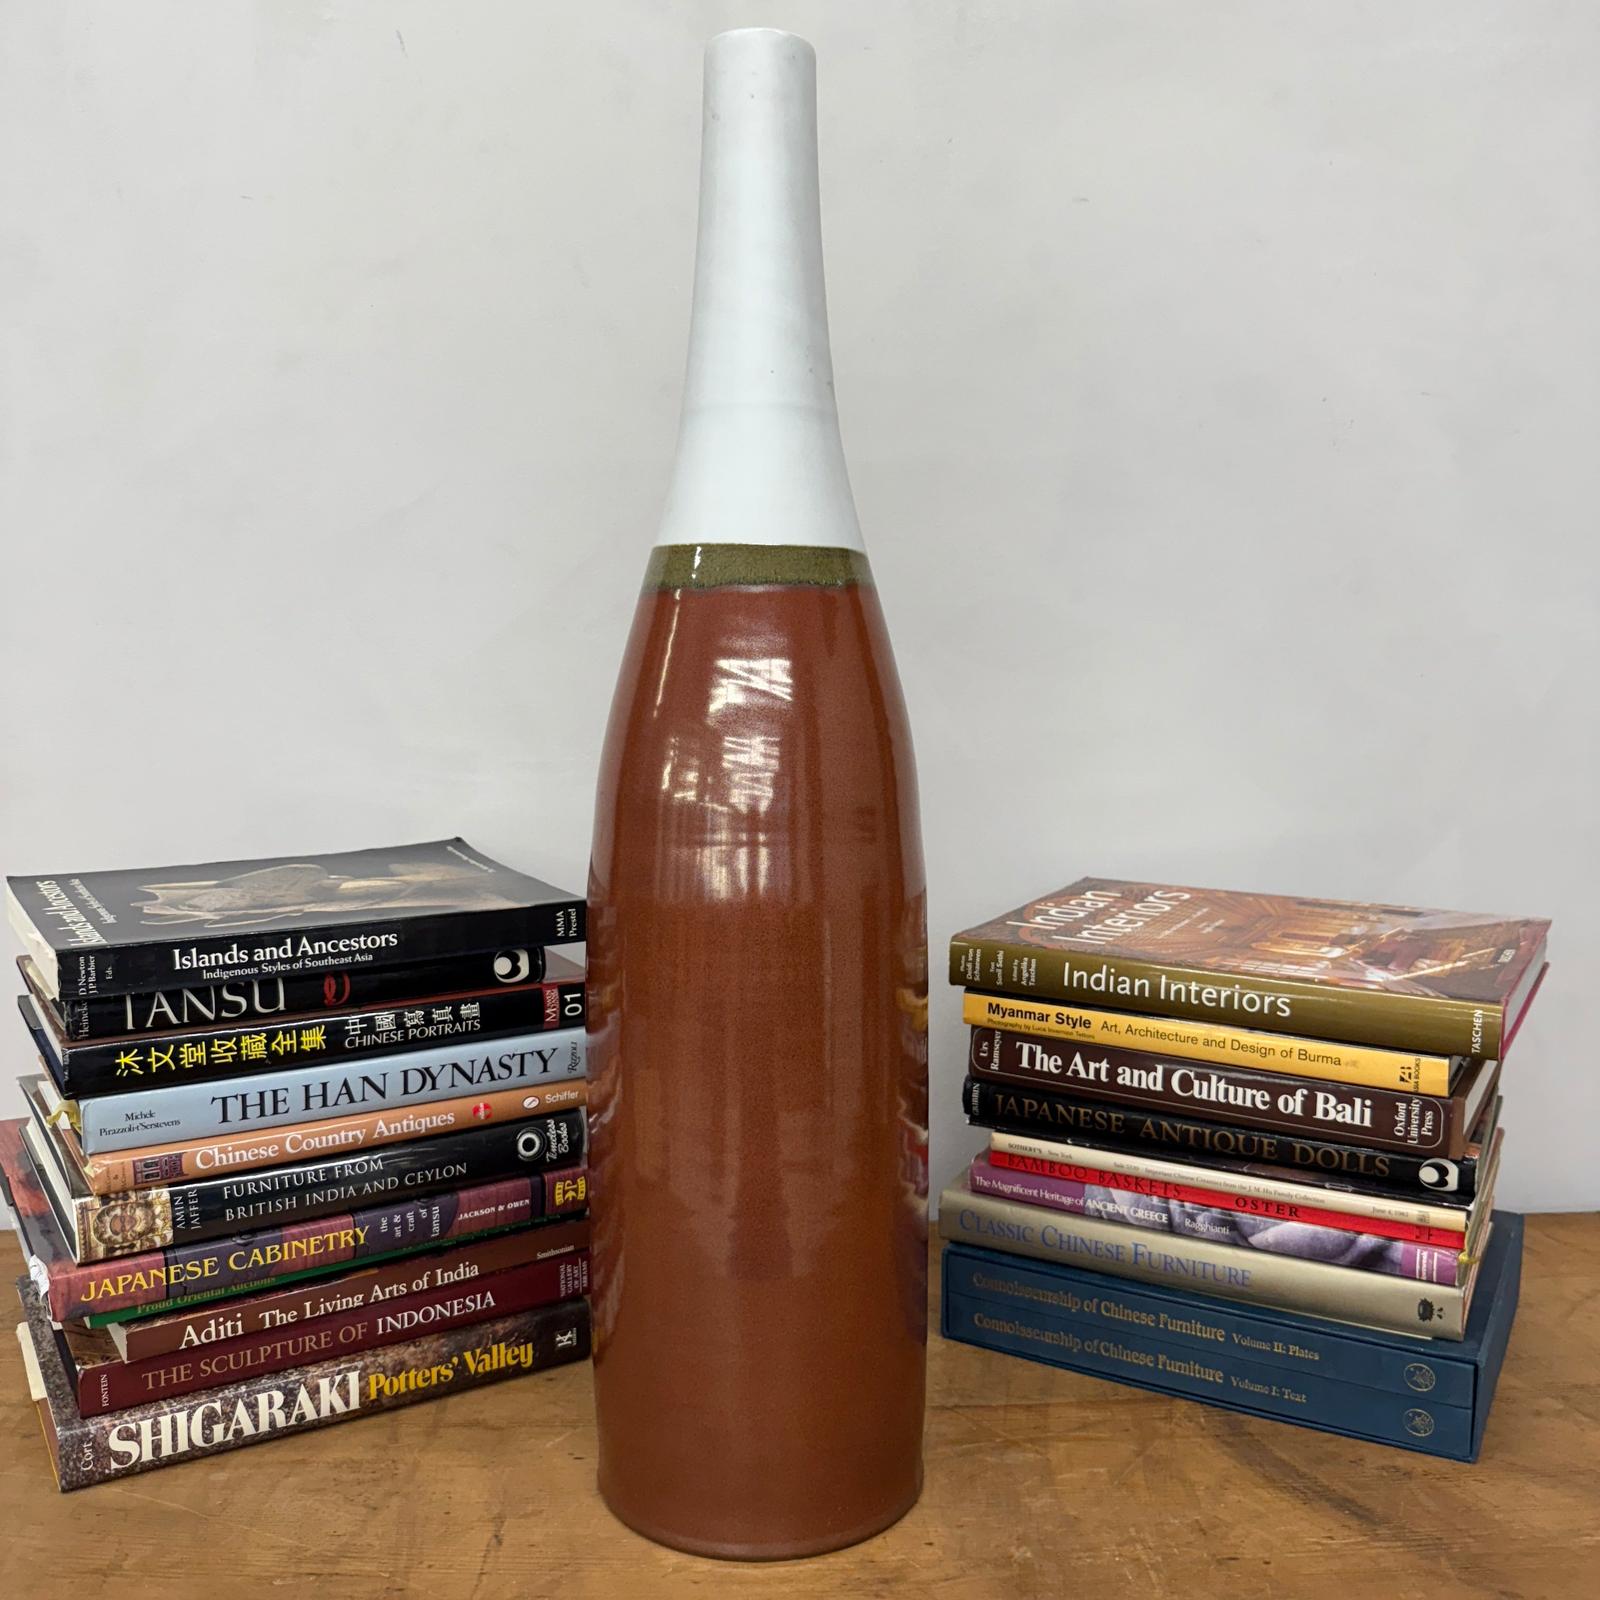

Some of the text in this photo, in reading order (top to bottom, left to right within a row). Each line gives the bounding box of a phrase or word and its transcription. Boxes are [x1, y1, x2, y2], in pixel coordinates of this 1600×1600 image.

[557, 911, 565, 937] MMA
[569, 908, 578, 937] Prestel
[1006, 890, 1122, 930] Indian
[1052, 890, 1191, 945] Interiors
[173, 932, 398, 970] Islands and Ancestors
[203, 953, 373, 980] Indigenous Styles of Southeast Asia
[996, 950, 1004, 968] Sethi
[78, 956, 86, 985] Newton
[88, 954, 96, 981] Barbier
[1021, 957, 1029, 986] Angelika
[1028, 958, 1036, 986] Taschen
[565, 993, 582, 1016] 01
[1063, 961, 1291, 1017] Indian Interiors
[987, 1001, 1092, 1030] Myanmar Style
[1472, 1009, 1483, 1054] TASCHEN
[345, 1019, 480, 1049] CHINESE PORTRAITS
[979, 1041, 988, 1057] Urs
[1100, 1021, 1341, 1066] Art, Architecture and Design of Burma
[115, 1025, 326, 1077] 沐文堂收藏全集
[990, 1031, 1001, 1070] Ramseyer
[211, 1048, 558, 1124] THE HAN DYNASTY
[545, 1090, 580, 1104] Schiffer
[972, 1083, 980, 1115] GRIBBIN
[1016, 1042, 1372, 1128] The Art and Culture of Bali
[1394, 1102, 1407, 1136] Oxford
[1407, 1096, 1422, 1144] University
[1421, 1110, 1433, 1136] Press
[196, 1143, 279, 1170] Chinese
[285, 1126, 366, 1154] Country
[373, 1112, 455, 1140] Antiques
[558, 1122, 569, 1153] Books
[995, 1094, 1390, 1177] JAPANESE ANTIQUE DOLLS
[223, 1158, 384, 1199] FURNITURE FROM
[1008, 1152, 1182, 1198] BAMBOO BASKETS
[225, 1162, 468, 1222] BRITISH INDIA AND CEYLON
[975, 1176, 1168, 1224] The Magnificent Heritage of ANCIENT GREECE
[1235, 1196, 1299, 1218] OSTER
[174, 1196, 185, 1230] AMIN
[190, 1189, 202, 1230] JAFFER
[380, 1217, 388, 1233] the
[394, 1214, 401, 1223] &
[419, 1208, 427, 1218] of
[431, 1206, 440, 1237] tansu
[458, 1199, 530, 1220] JACKSON & OWEN
[1185, 1218, 1229, 1234] Ragghianti
[81, 1225, 369, 1302] JAPANESE CABINETRY
[536, 1244, 575, 1260] Smithsonian
[136, 1299, 173, 1314] Proud
[177, 1288, 225, 1304] Oriental
[573, 1281, 579, 1291] OF
[180, 1262, 479, 1350] Aditi The Living Arts of India
[973, 1272, 1320, 1360] Connoisseurship of Chinese Furniture Volume II: Plates
[142, 1291, 496, 1390] THE SCULPTURE OF INDONESIA
[974, 1313, 1307, 1403] Connoisseurship of Chinese Furniture Volume I: Text
[101, 1374, 109, 1407] FONTEIN
[108, 1370, 361, 1470] SHIGARAKI
[463, 1342, 534, 1376] Valley
[80, 1440, 93, 1471] Cort
